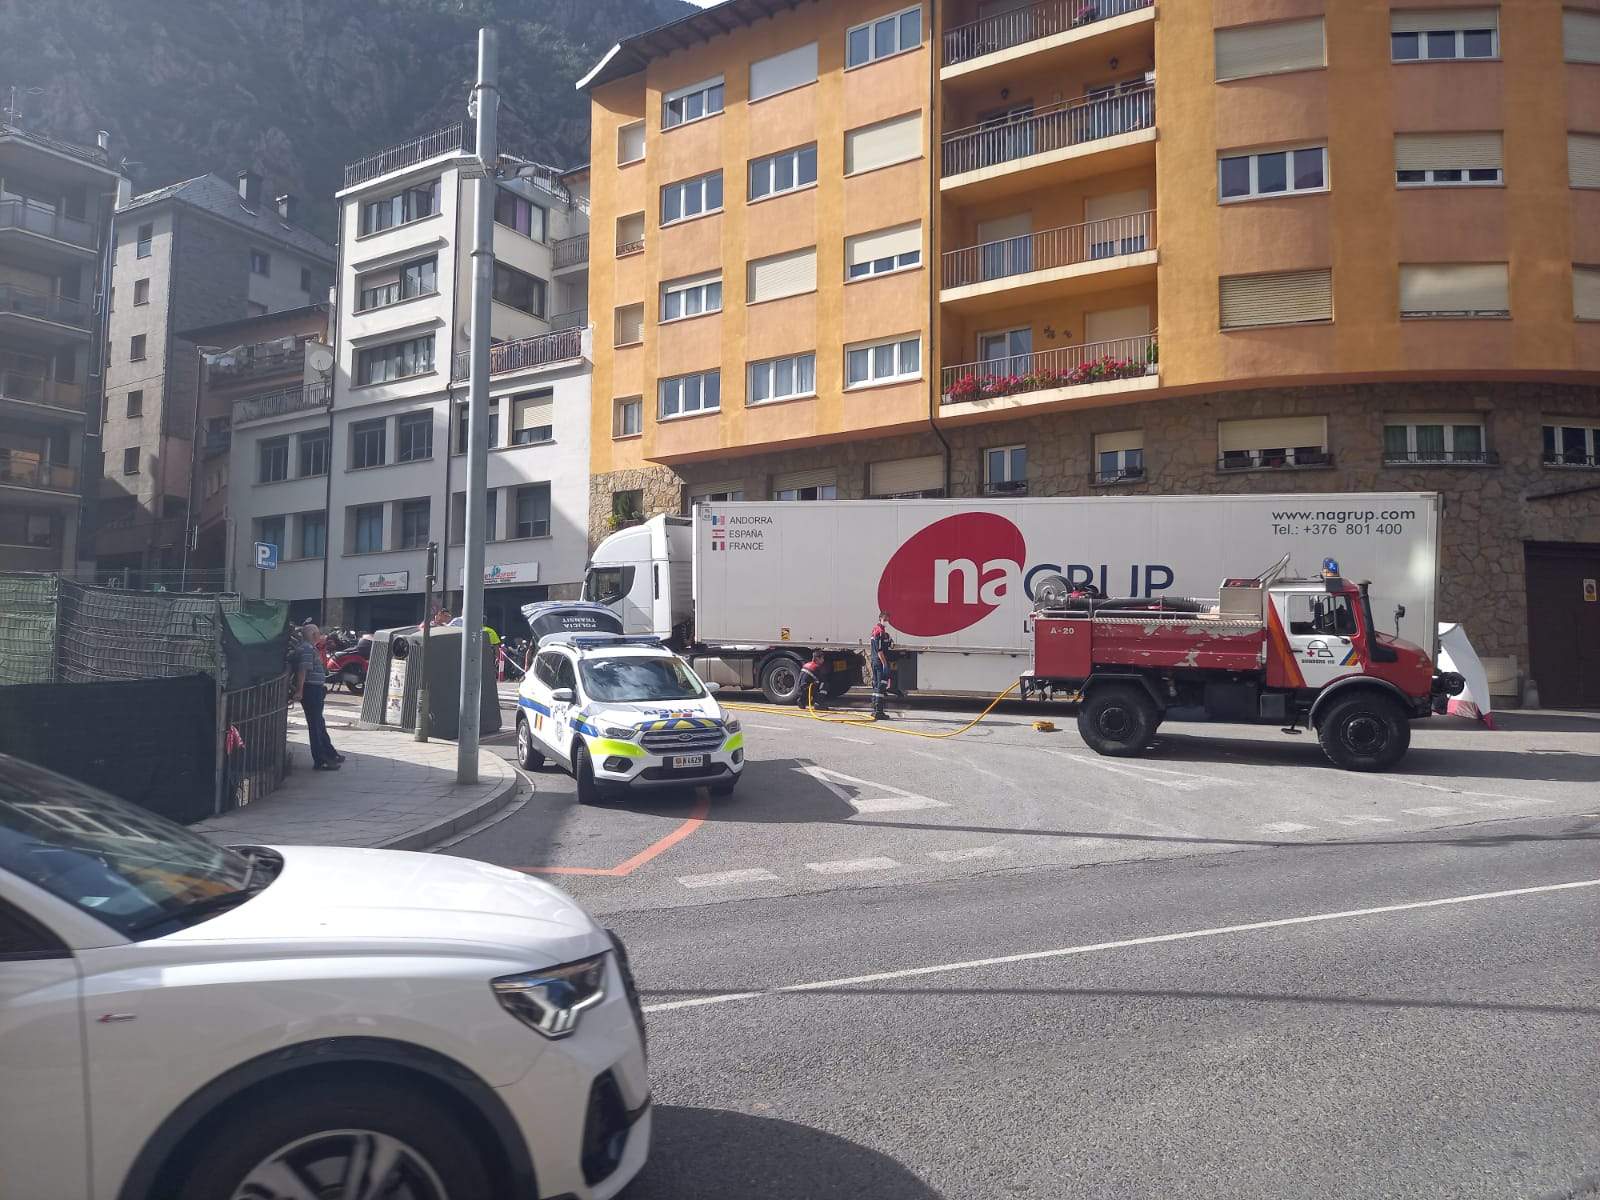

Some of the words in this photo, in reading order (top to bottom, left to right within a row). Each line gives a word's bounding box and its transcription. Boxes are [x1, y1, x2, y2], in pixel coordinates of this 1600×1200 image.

[729, 516, 773, 524] ANDORRA
[1272, 510, 1415, 523] www.nagrup.com
[729, 529, 763, 538] ESPAÑA
[1303, 524, 1337, 535] +376
[1346, 524, 1370, 535] 801
[1376, 524, 1402, 535] 400
[729, 542, 764, 550] FRANCE
[258, 545, 270, 564] P
[934, 558, 1021, 605] na
[1050, 627, 1075, 635] A-20
